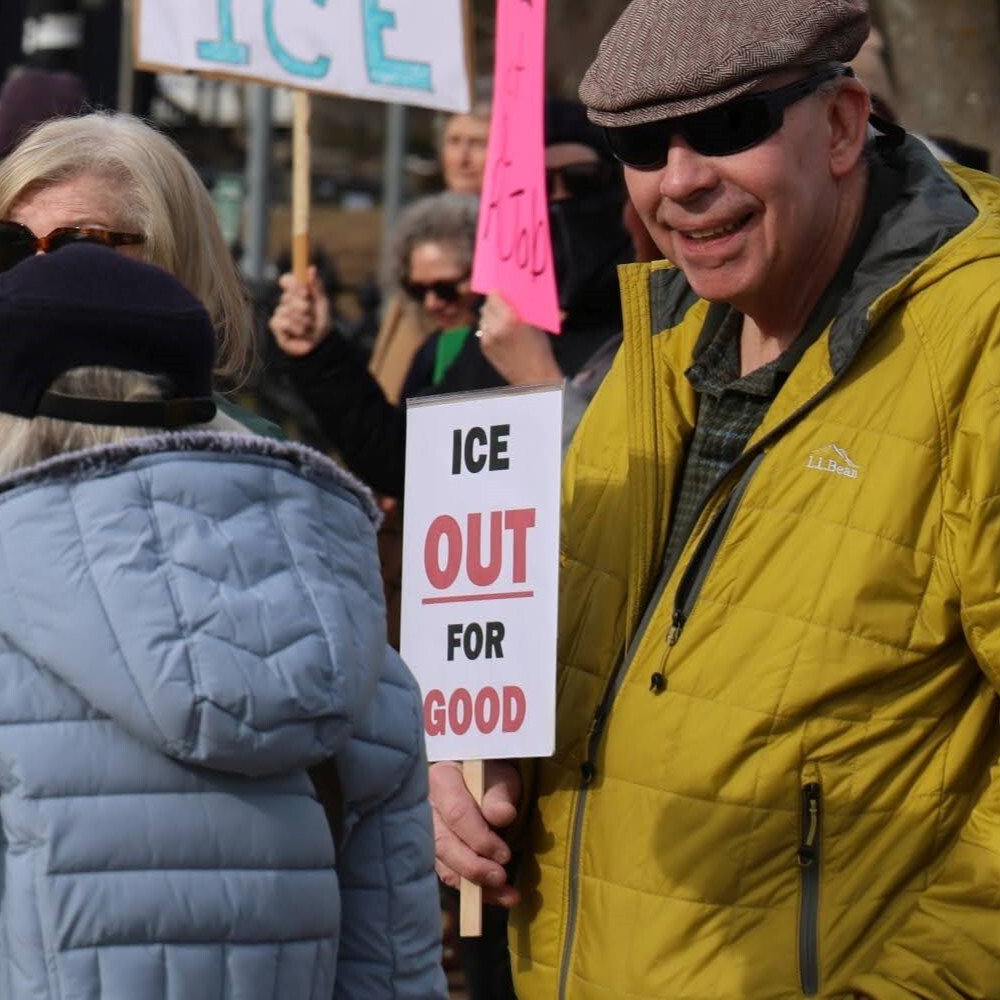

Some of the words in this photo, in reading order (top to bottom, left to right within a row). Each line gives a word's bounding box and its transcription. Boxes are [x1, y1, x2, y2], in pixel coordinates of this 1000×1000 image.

[451, 423, 511, 475] ICE
[424, 508, 536, 590] OUT
[446, 621, 506, 662] FOR
[423, 685, 526, 737] GOOD
